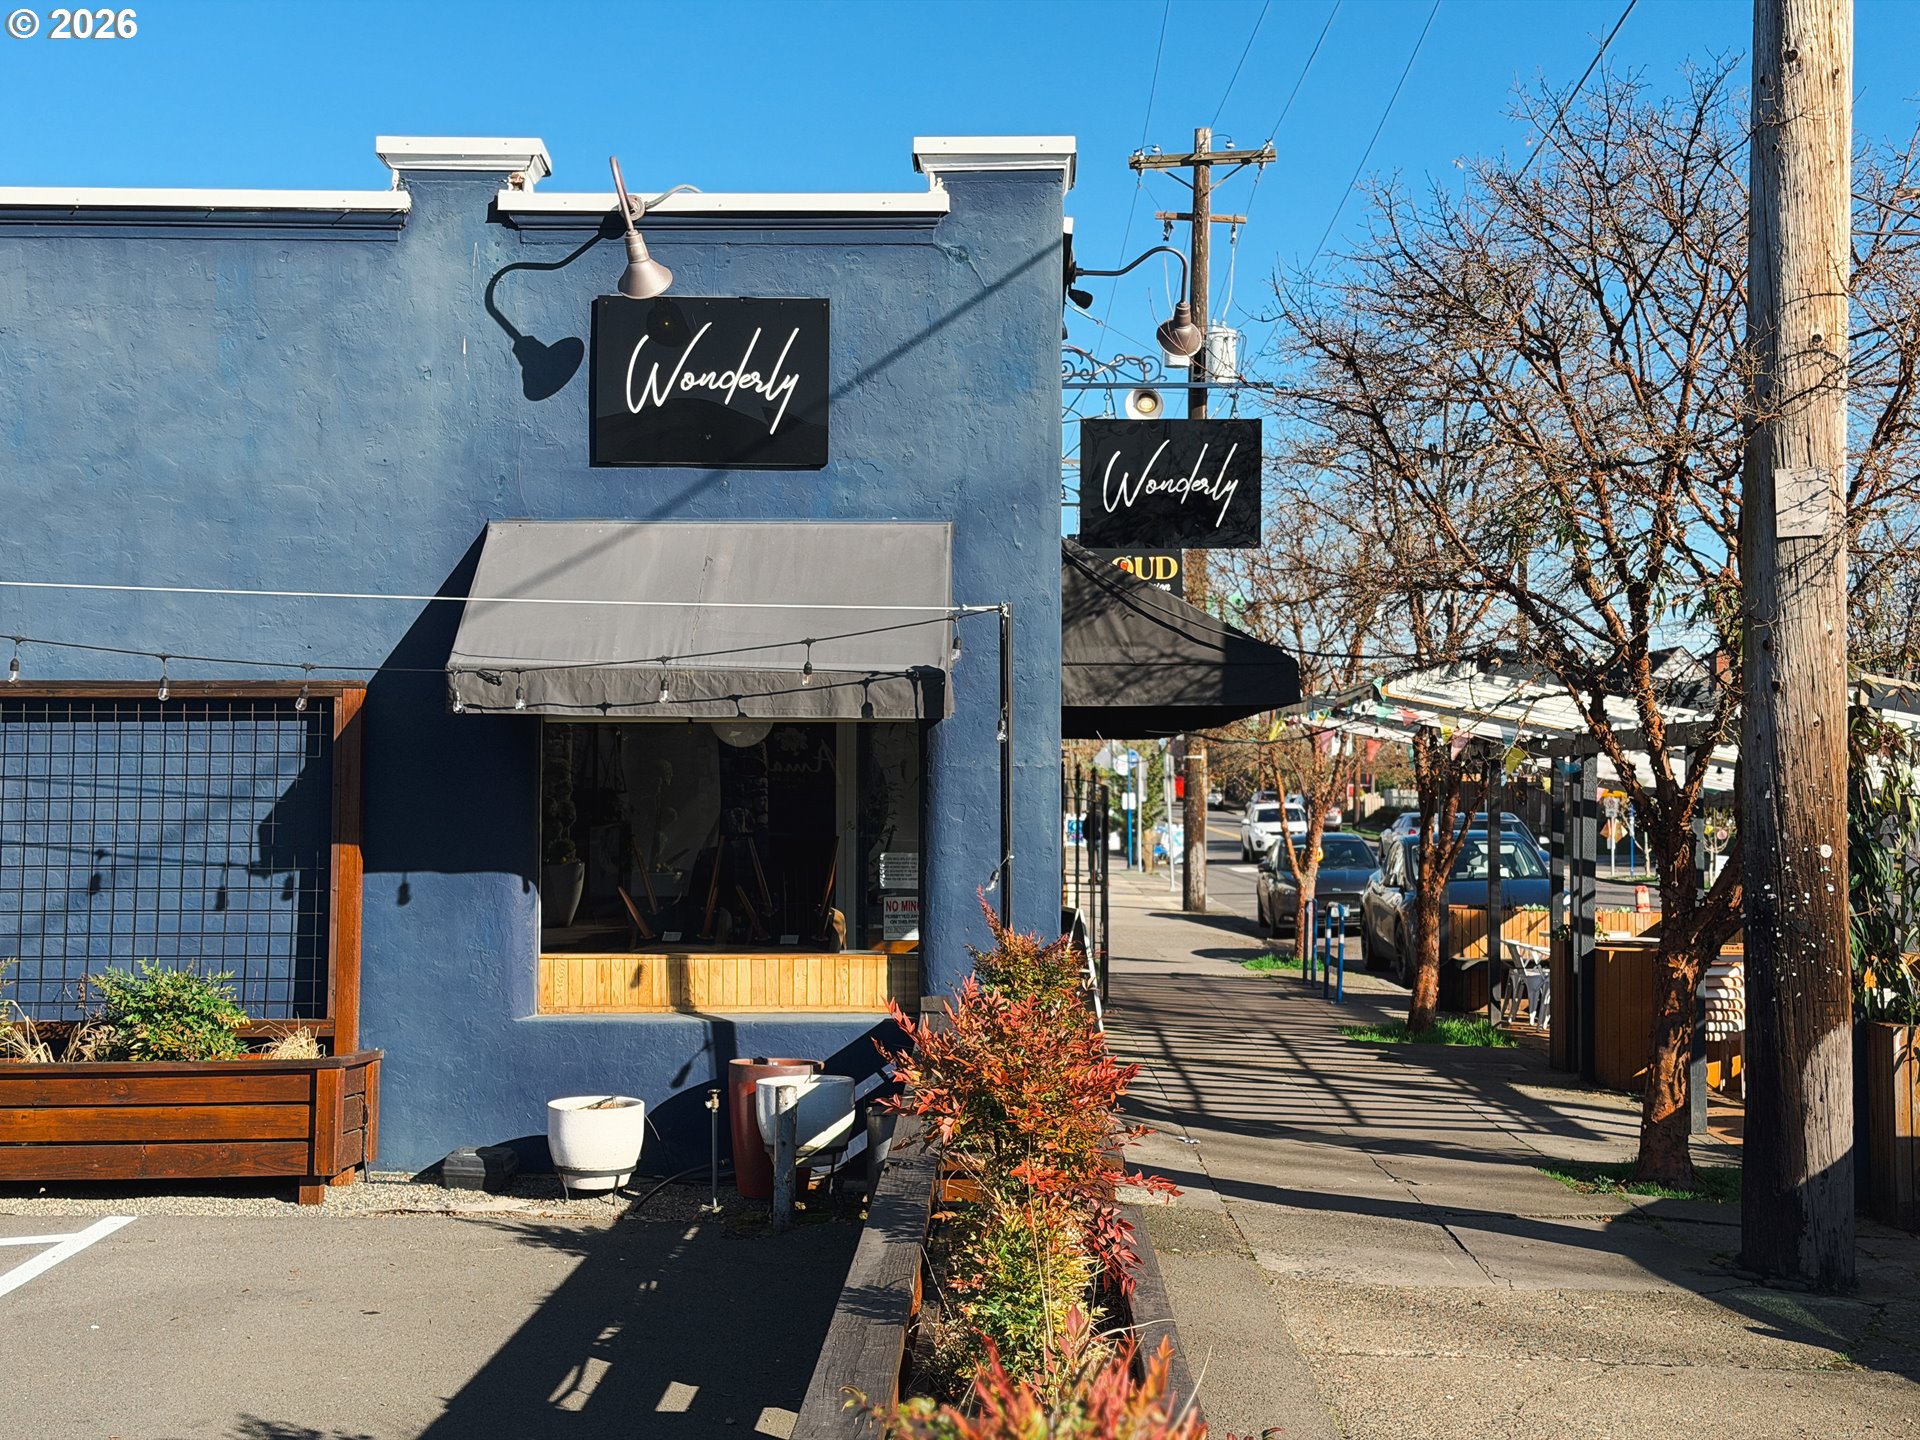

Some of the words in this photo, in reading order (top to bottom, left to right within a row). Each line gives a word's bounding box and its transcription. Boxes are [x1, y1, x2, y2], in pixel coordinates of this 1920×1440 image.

[626, 321, 800, 436] Wonderly
[1103, 439, 1239, 528] Wonderly
[885, 900, 899, 912] NO
